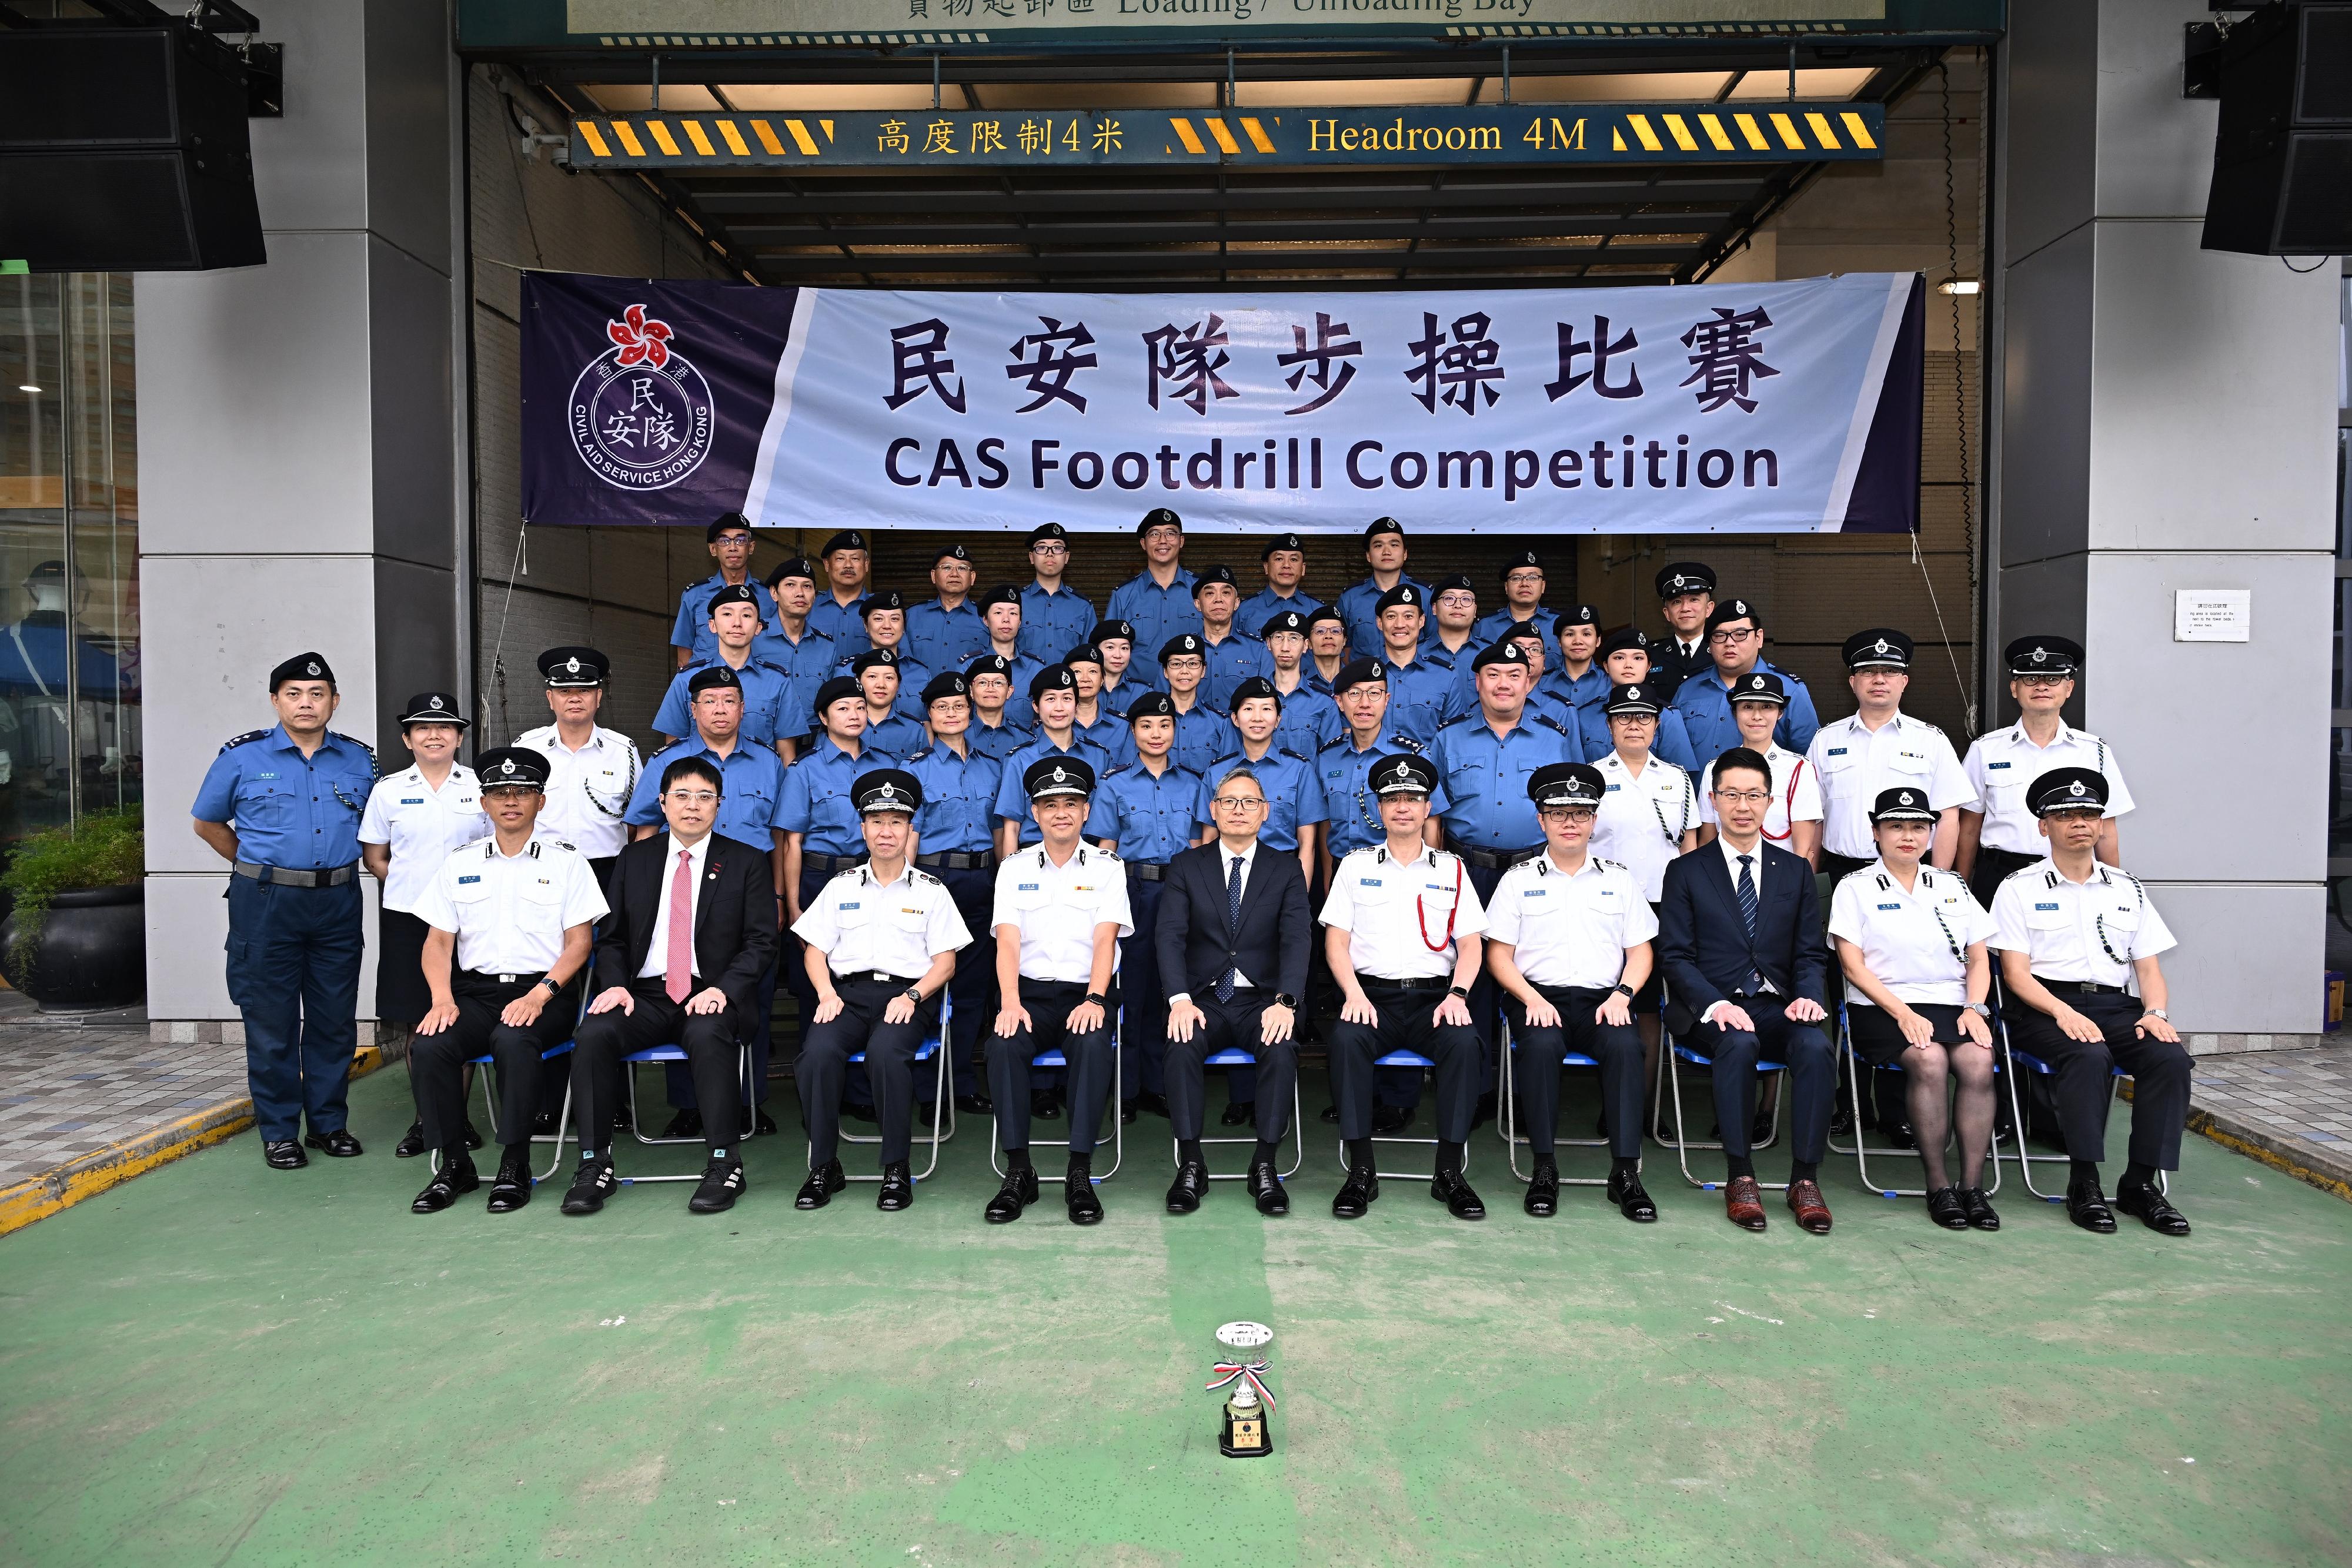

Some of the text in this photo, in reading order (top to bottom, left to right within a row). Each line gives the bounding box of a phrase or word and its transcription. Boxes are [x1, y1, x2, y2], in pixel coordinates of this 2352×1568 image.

[878, 118, 1123, 155] 高度限制4米
[1308, 118, 1588, 151] Headroom 4M
[883, 306, 1780, 416] 民安隊步操比賽
[576, 404, 707, 483] CIVIL AID SERVICE HONG KONG
[884, 434, 1778, 502] CAS Footdrill Competition
